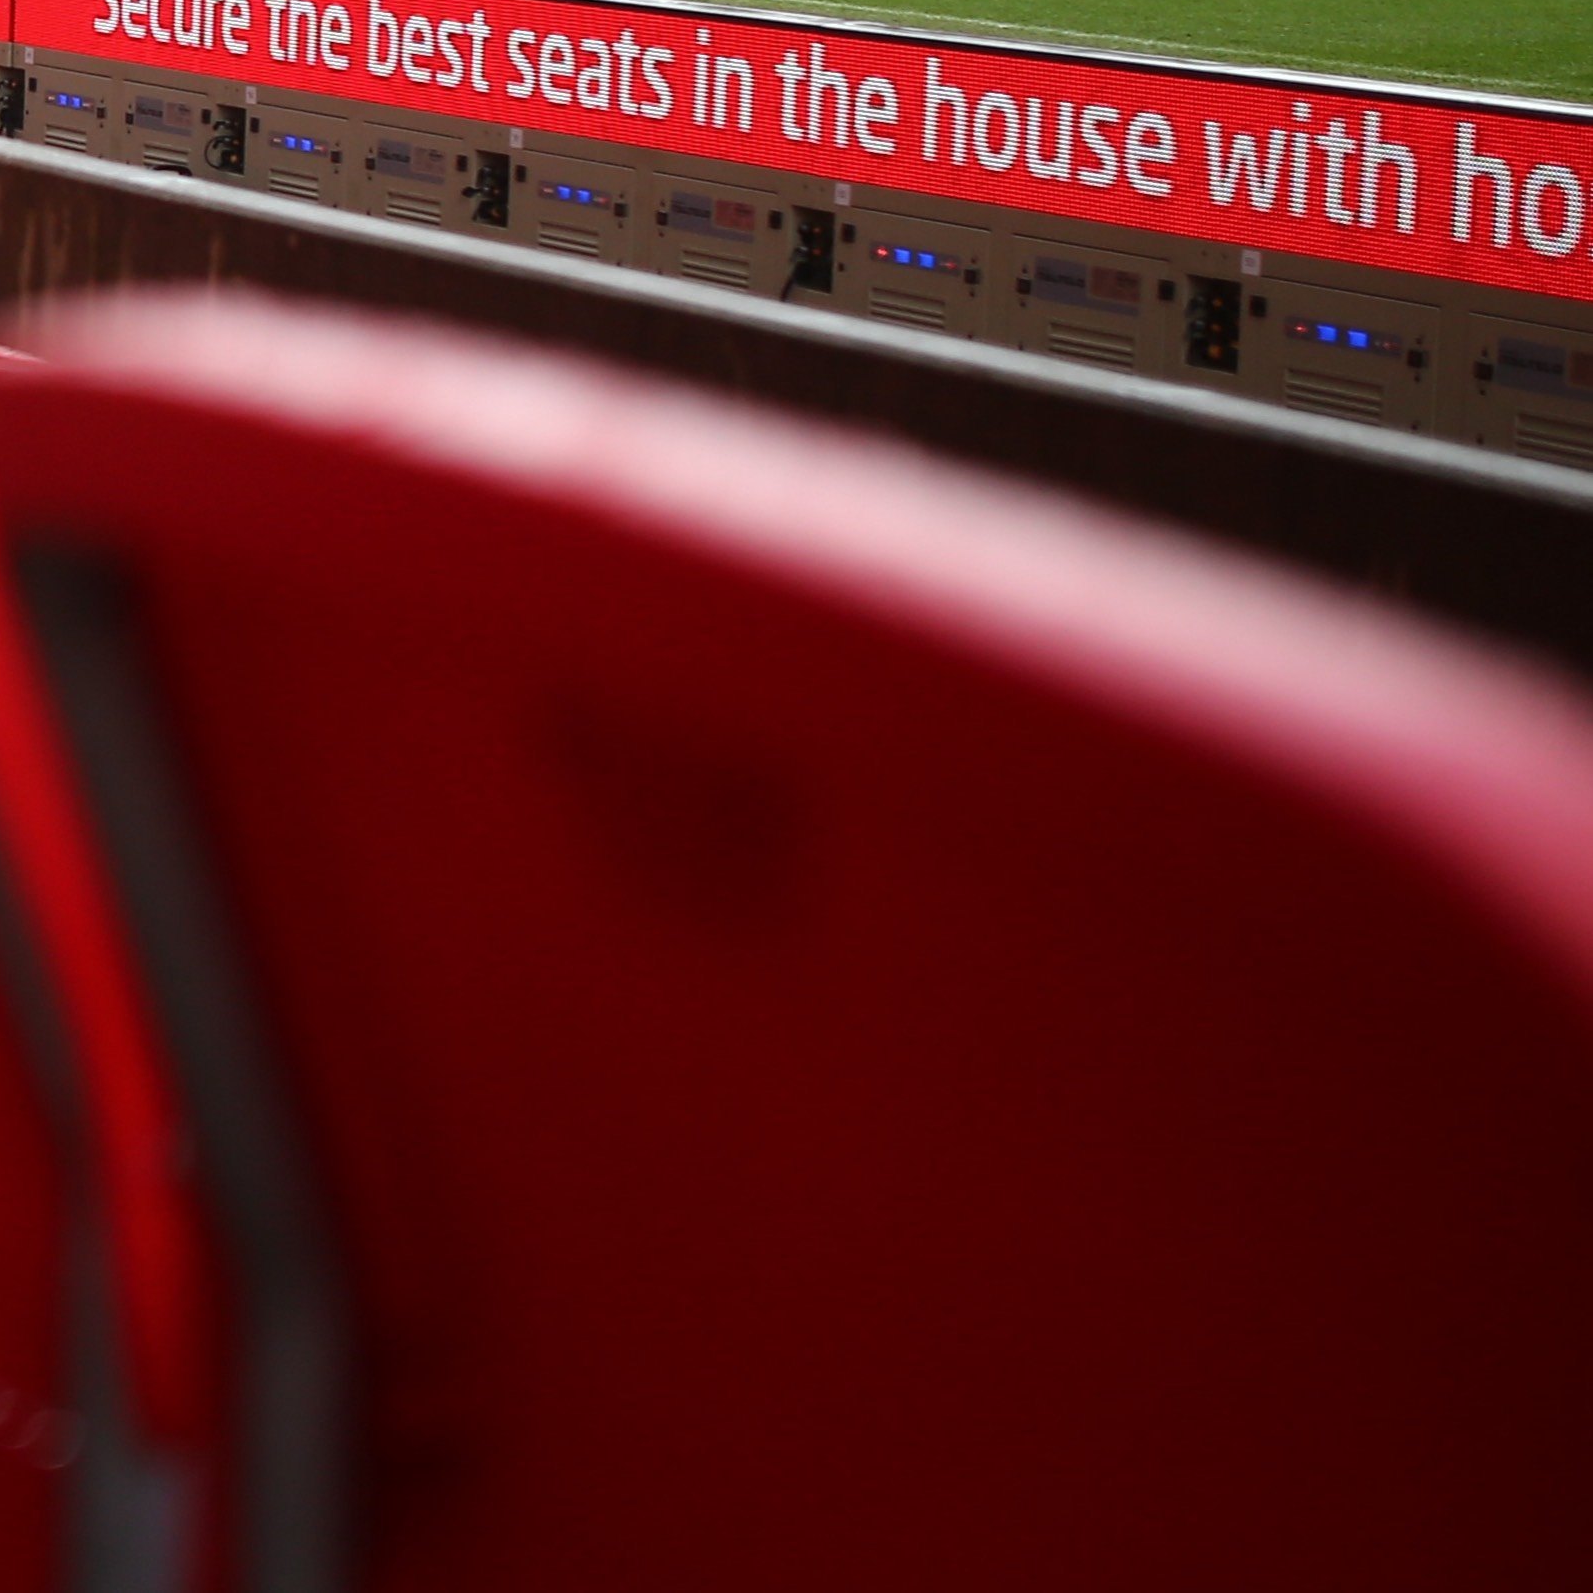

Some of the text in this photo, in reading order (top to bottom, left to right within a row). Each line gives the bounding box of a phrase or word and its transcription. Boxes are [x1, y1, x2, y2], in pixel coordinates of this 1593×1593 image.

[505, 27, 675, 120] seats
[693, 28, 755, 135] in
[774, 41, 899, 157] the
[922, 56, 1177, 198] house
[1202, 101, 1417, 235] with
